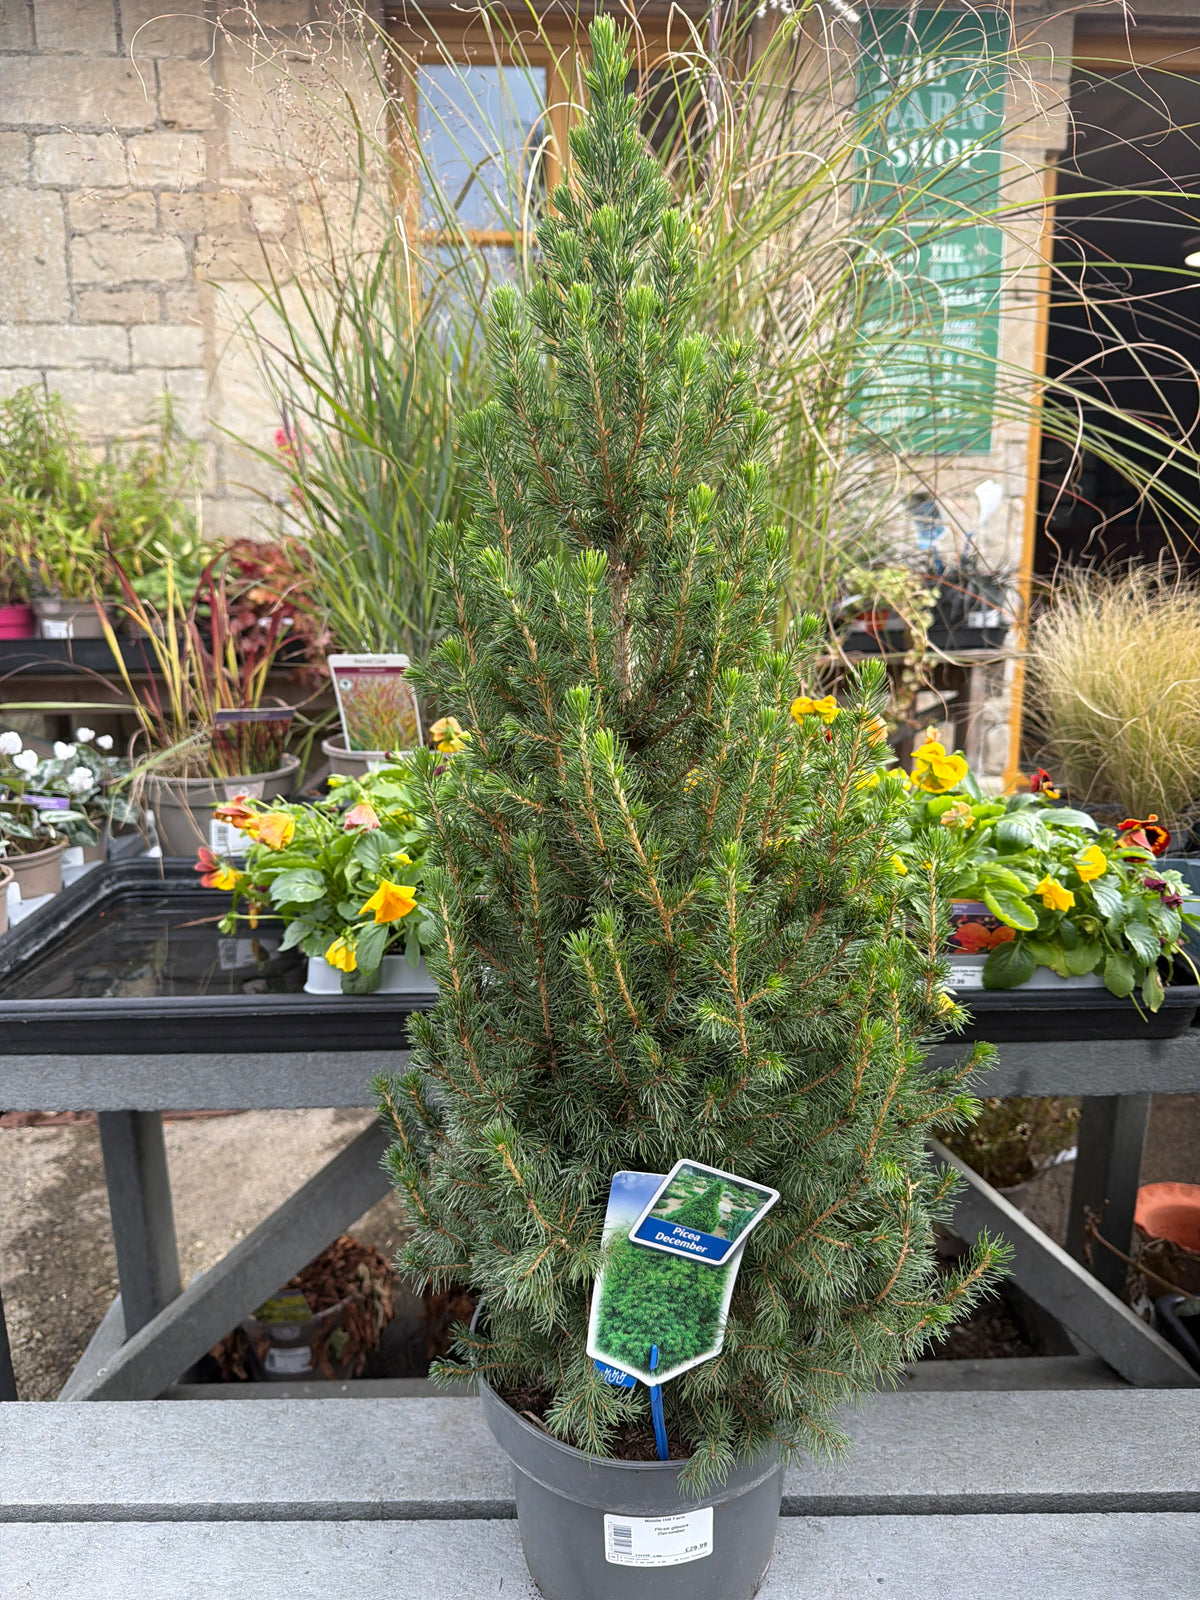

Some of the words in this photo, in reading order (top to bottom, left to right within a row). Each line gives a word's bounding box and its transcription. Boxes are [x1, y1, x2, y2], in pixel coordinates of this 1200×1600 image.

[873, 90, 987, 130] BARN
[886, 136, 984, 169] SHOP
[654, 1231, 708, 1253] December
[672, 1226, 701, 1242] Picea
[657, 1528, 686, 1536] December
[685, 1541, 708, 1553] £29.99
